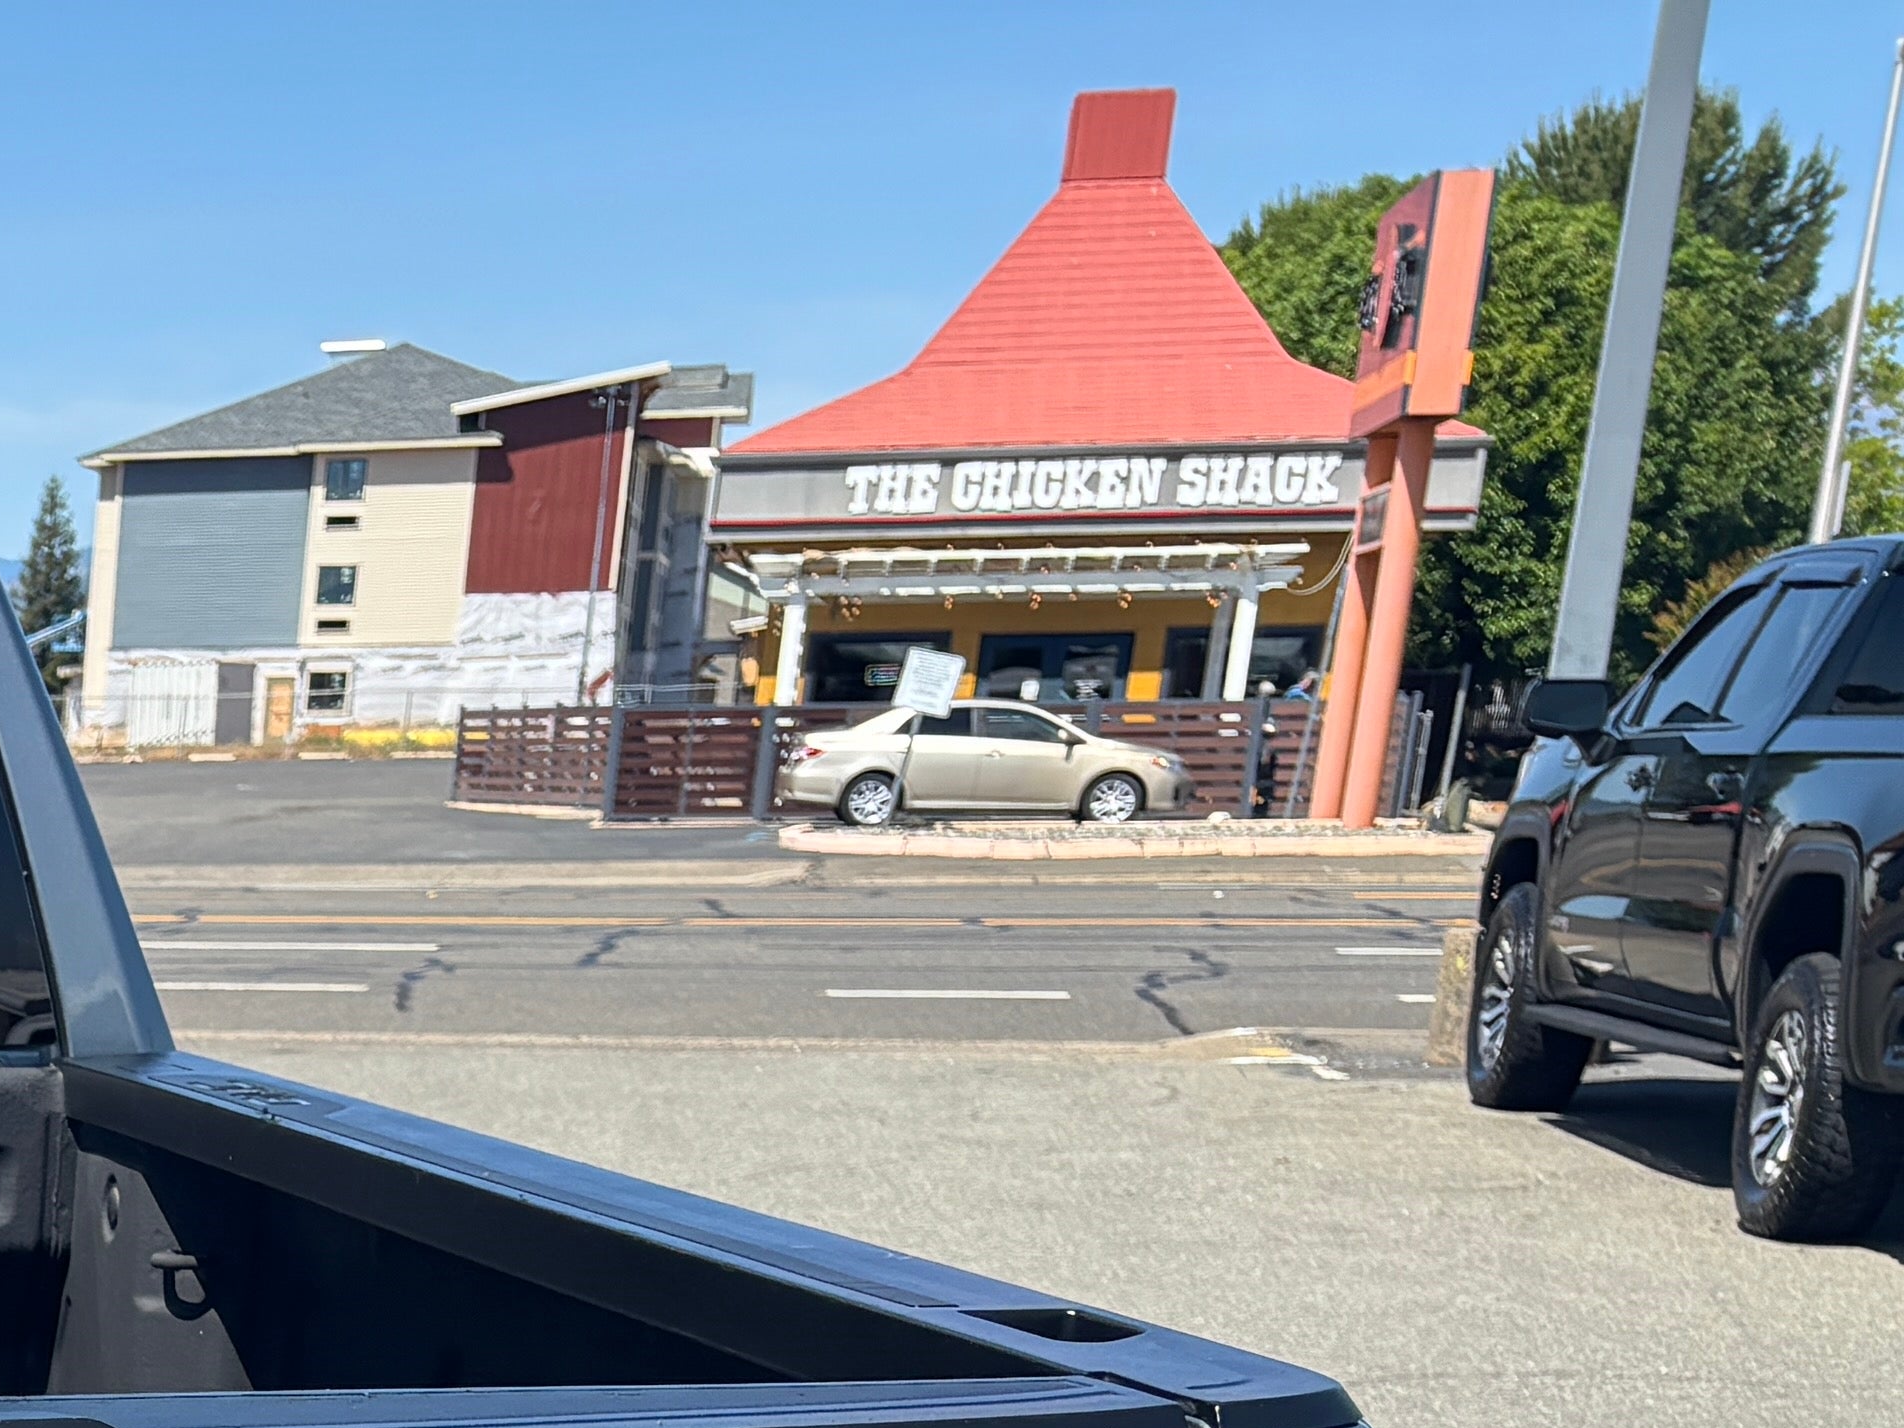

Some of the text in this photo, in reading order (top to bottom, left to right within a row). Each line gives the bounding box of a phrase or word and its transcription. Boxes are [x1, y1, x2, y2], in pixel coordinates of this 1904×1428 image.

[844, 451, 1343, 515] THE CHICKEN SHACK
